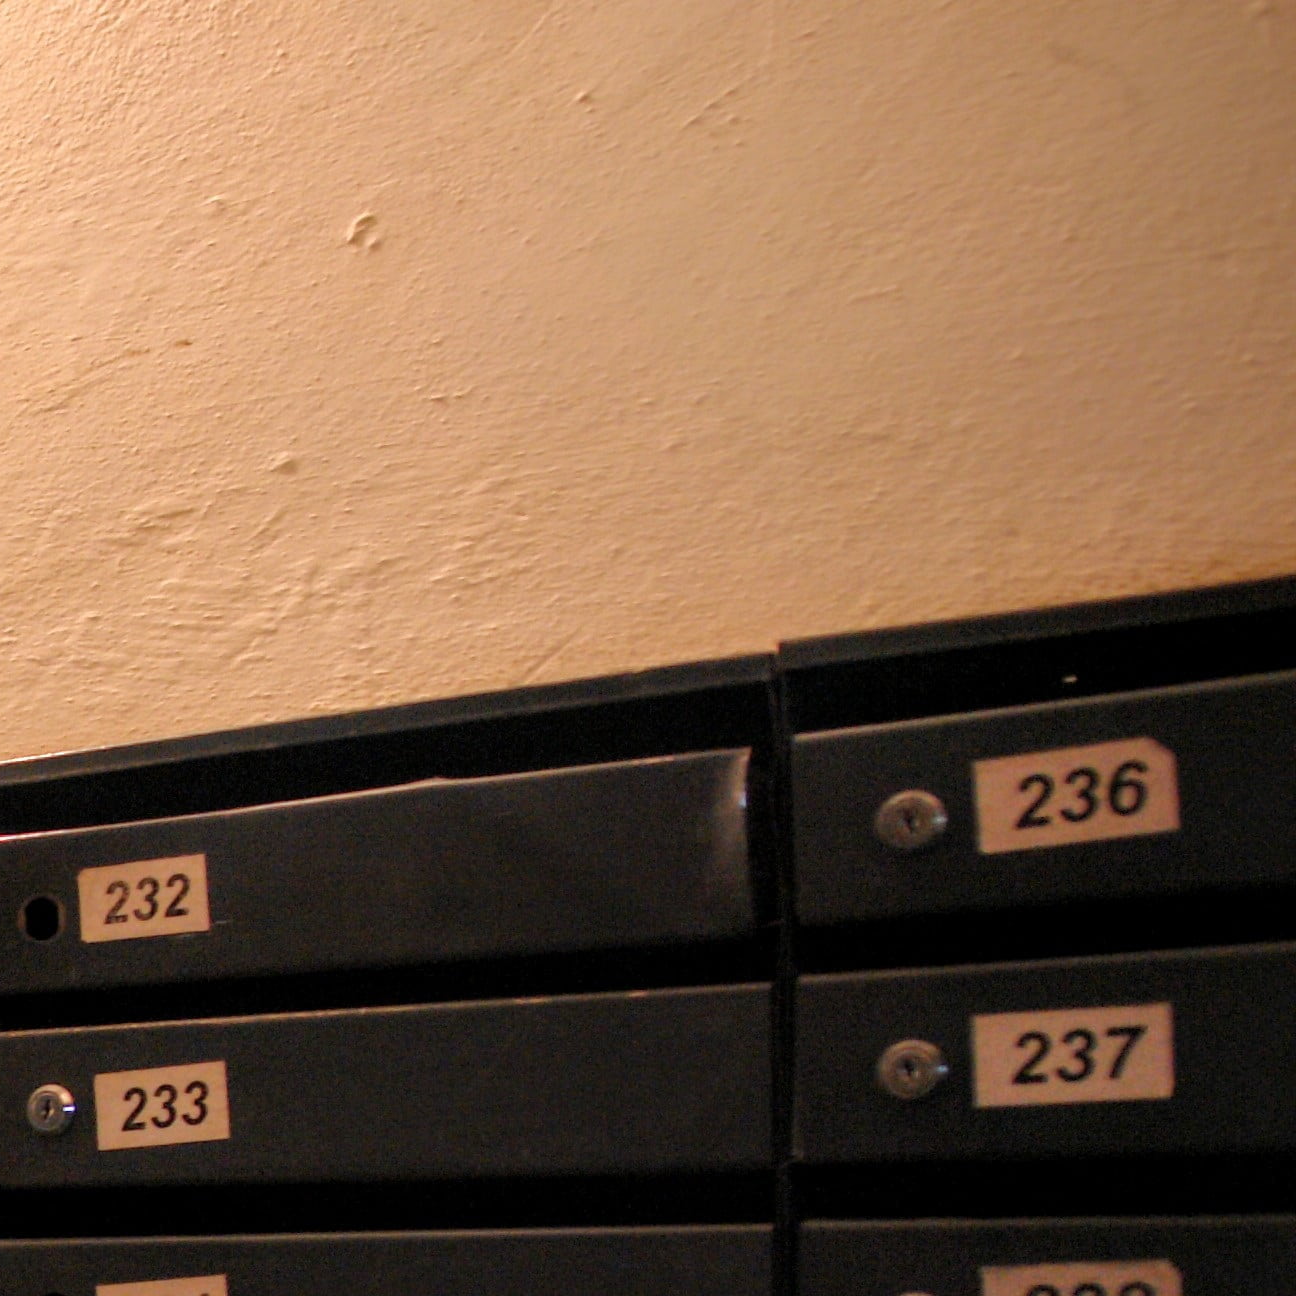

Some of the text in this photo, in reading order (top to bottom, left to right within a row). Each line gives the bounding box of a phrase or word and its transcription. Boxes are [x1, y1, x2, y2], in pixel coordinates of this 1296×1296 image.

[1016, 759, 1148, 831] 236
[104, 873, 191, 925] 232
[1012, 1025, 1148, 1085] 237
[121, 1080, 209, 1132] 233
